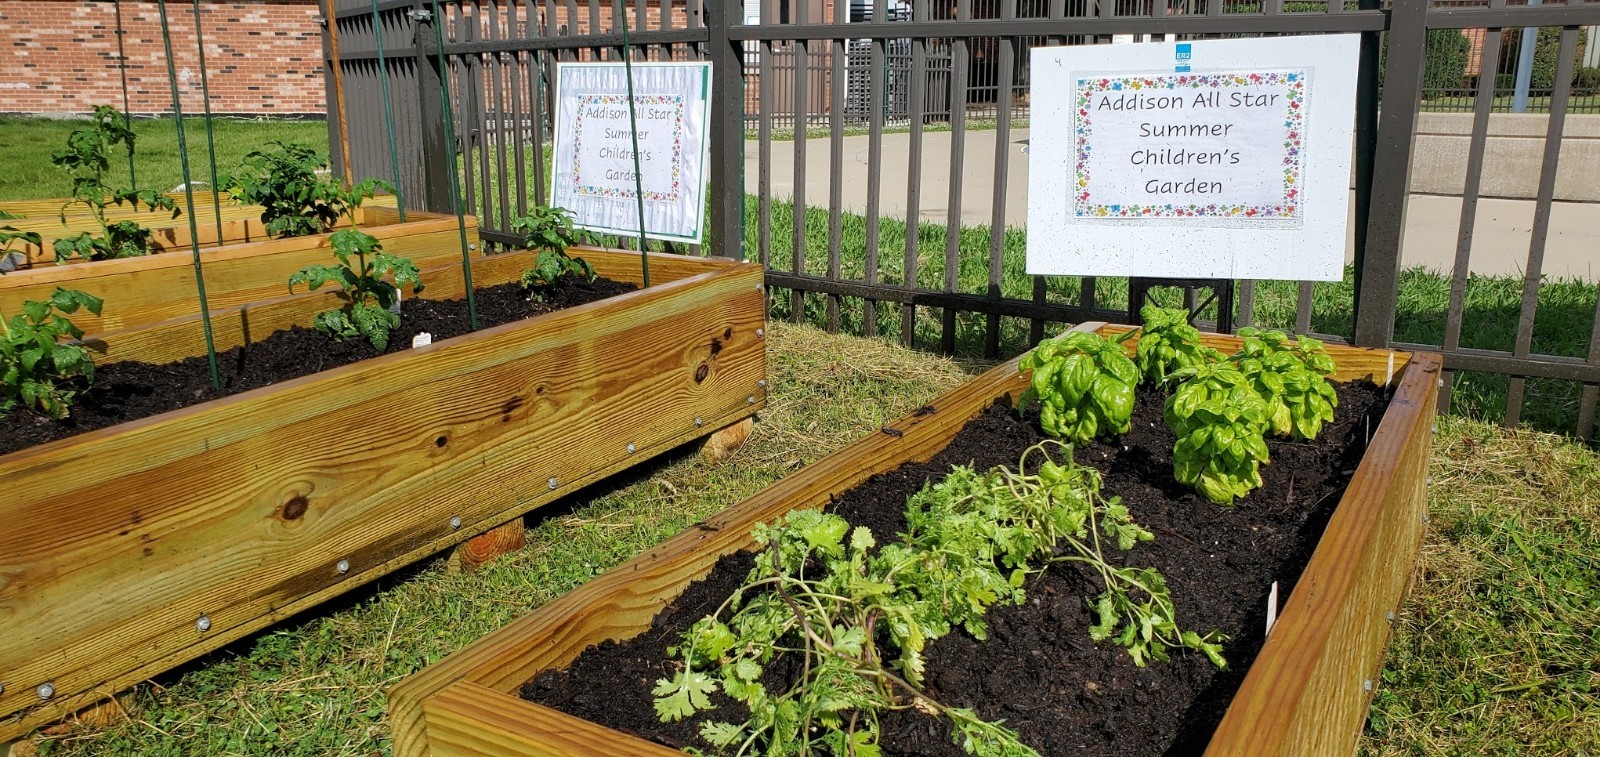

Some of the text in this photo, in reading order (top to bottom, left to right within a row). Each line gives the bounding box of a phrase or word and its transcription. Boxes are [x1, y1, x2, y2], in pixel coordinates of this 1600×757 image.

[1098, 91, 1280, 112] Addison All Star
[585, 106, 627, 120] Addison
[647, 108, 672, 120] Star
[1139, 121, 1234, 138] Summer
[599, 146, 652, 161] Children's
[1130, 148, 1241, 166] Children's
[605, 168, 643, 182] Garden
[1145, 178, 1223, 195] Garden
